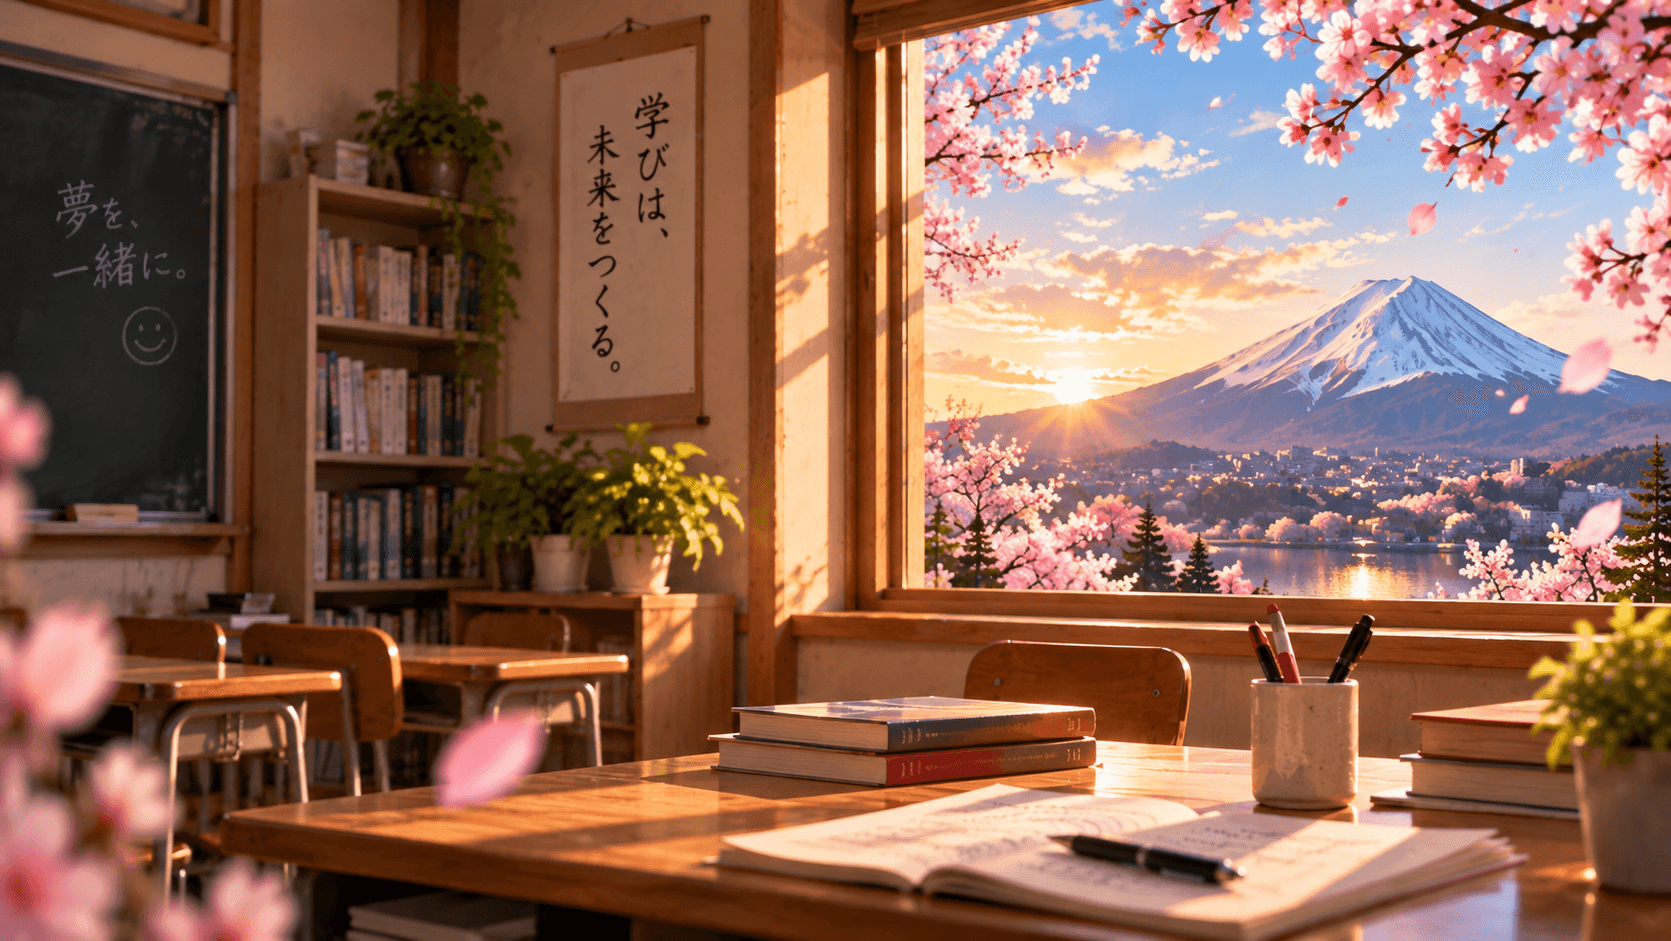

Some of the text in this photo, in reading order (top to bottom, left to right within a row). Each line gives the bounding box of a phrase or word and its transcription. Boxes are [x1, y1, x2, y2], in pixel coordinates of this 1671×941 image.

[56, 179, 138, 239] 夢を、
[635, 92, 670, 238] 学びは、
[53, 242, 186, 288] 一緒に。
[587, 124, 621, 373] 未来をつくる。
